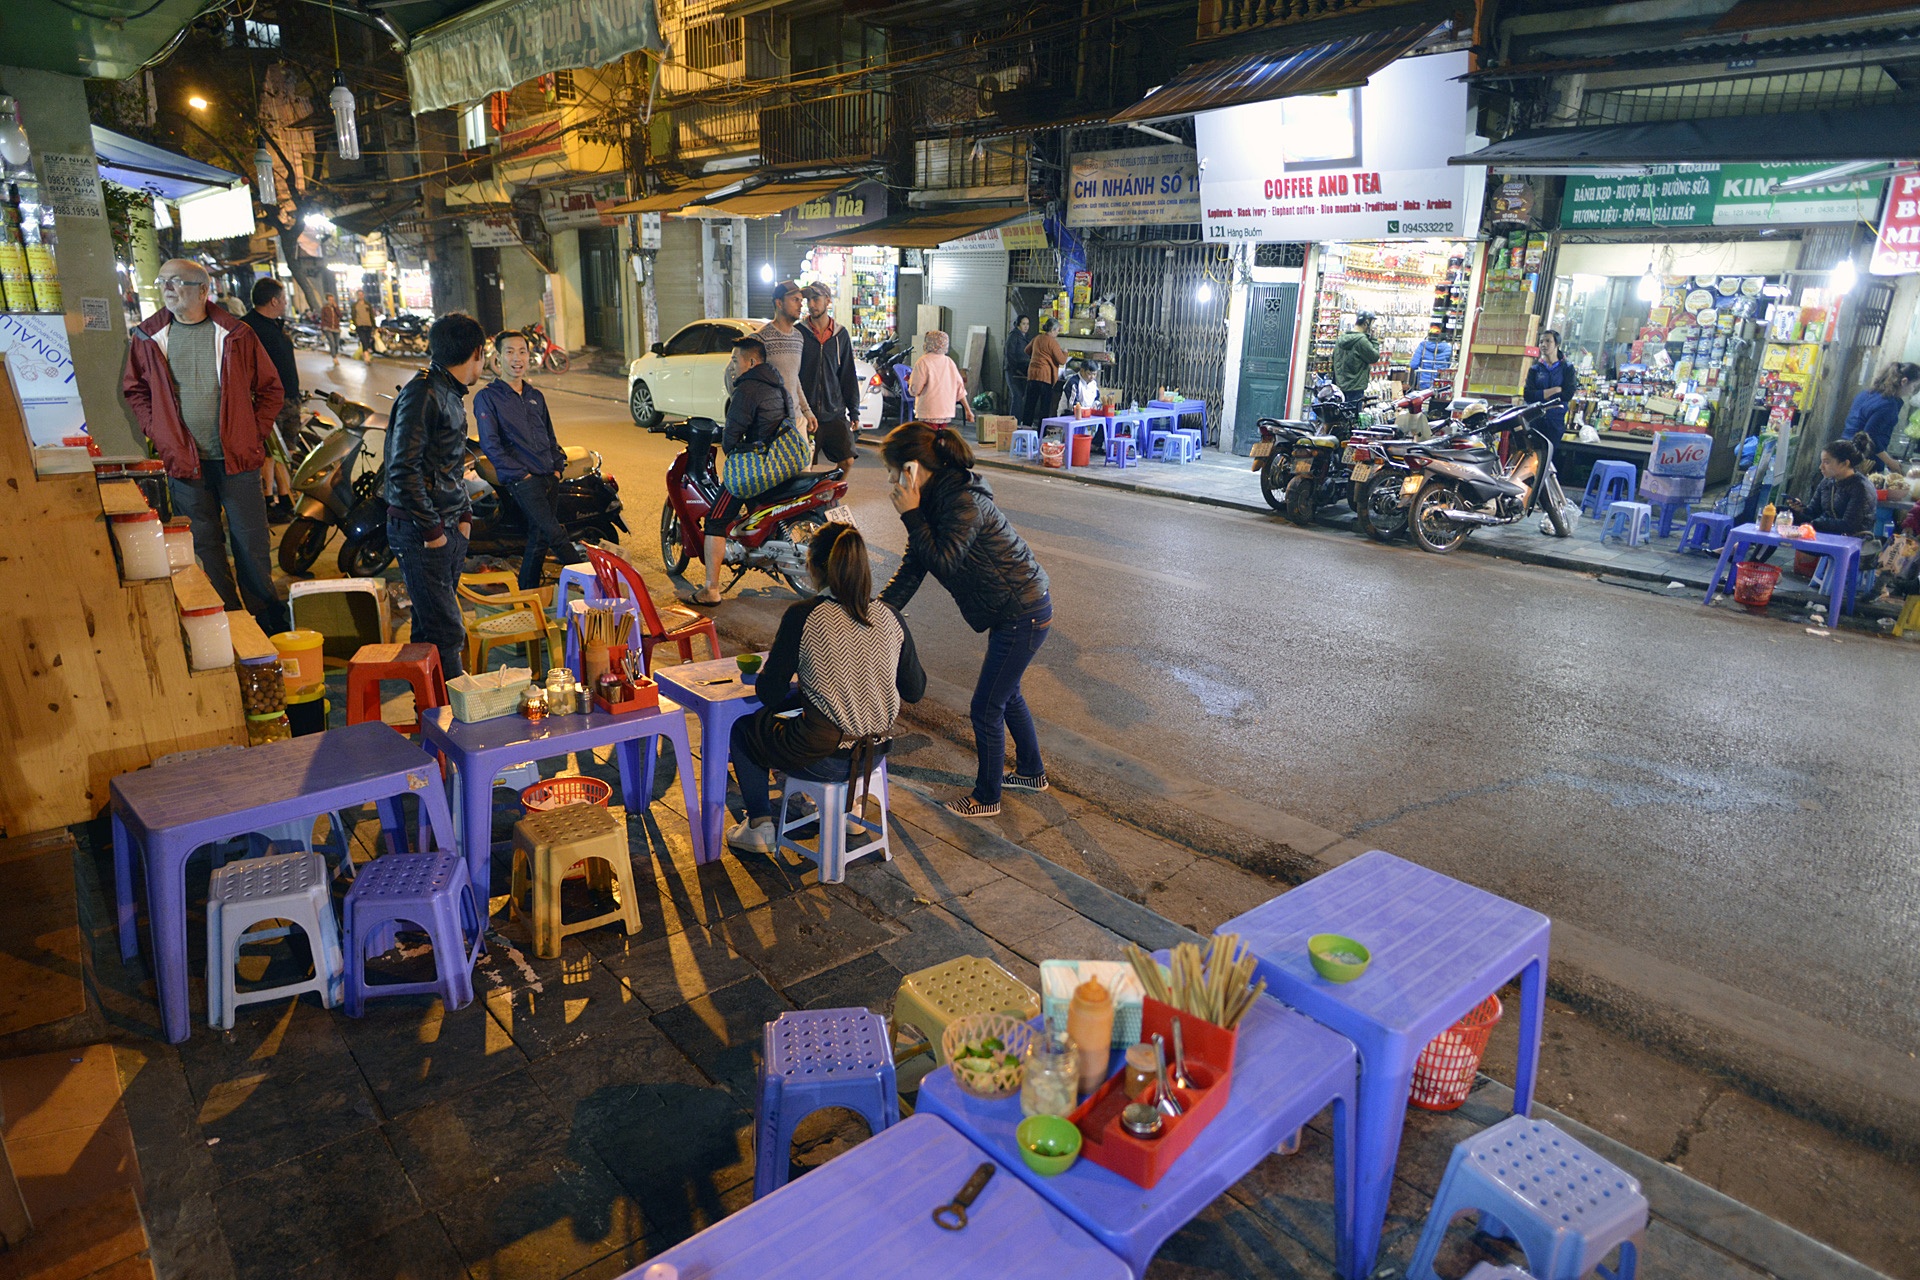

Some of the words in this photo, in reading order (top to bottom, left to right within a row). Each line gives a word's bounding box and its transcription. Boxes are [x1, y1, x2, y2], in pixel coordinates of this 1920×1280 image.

[1074, 180, 1097, 199] CHI
[1102, 173, 1155, 197] NHÁNH
[1160, 166, 1184, 194] SỐ
[1264, 176, 1314, 200] COFFEE
[1318, 174, 1349, 198] AND
[1352, 172, 1382, 195] TEA
[1574, 184, 1596, 202] BÁNH
[1596, 186, 1612, 203] KẸO
[1661, 177, 1691, 197] ĐƯỜNG
[834, 194, 864, 218] Hòa
[1271, 205, 1296, 217] Elephant
[1296, 205, 1315, 216] coffee
[1321, 204, 1333, 215] Blue
[1335, 202, 1361, 213] mountain
[1208, 225, 1227, 238] 121
[1227, 228, 1243, 239] Hàng
[1402, 222, 1454, 233] 0945332212
